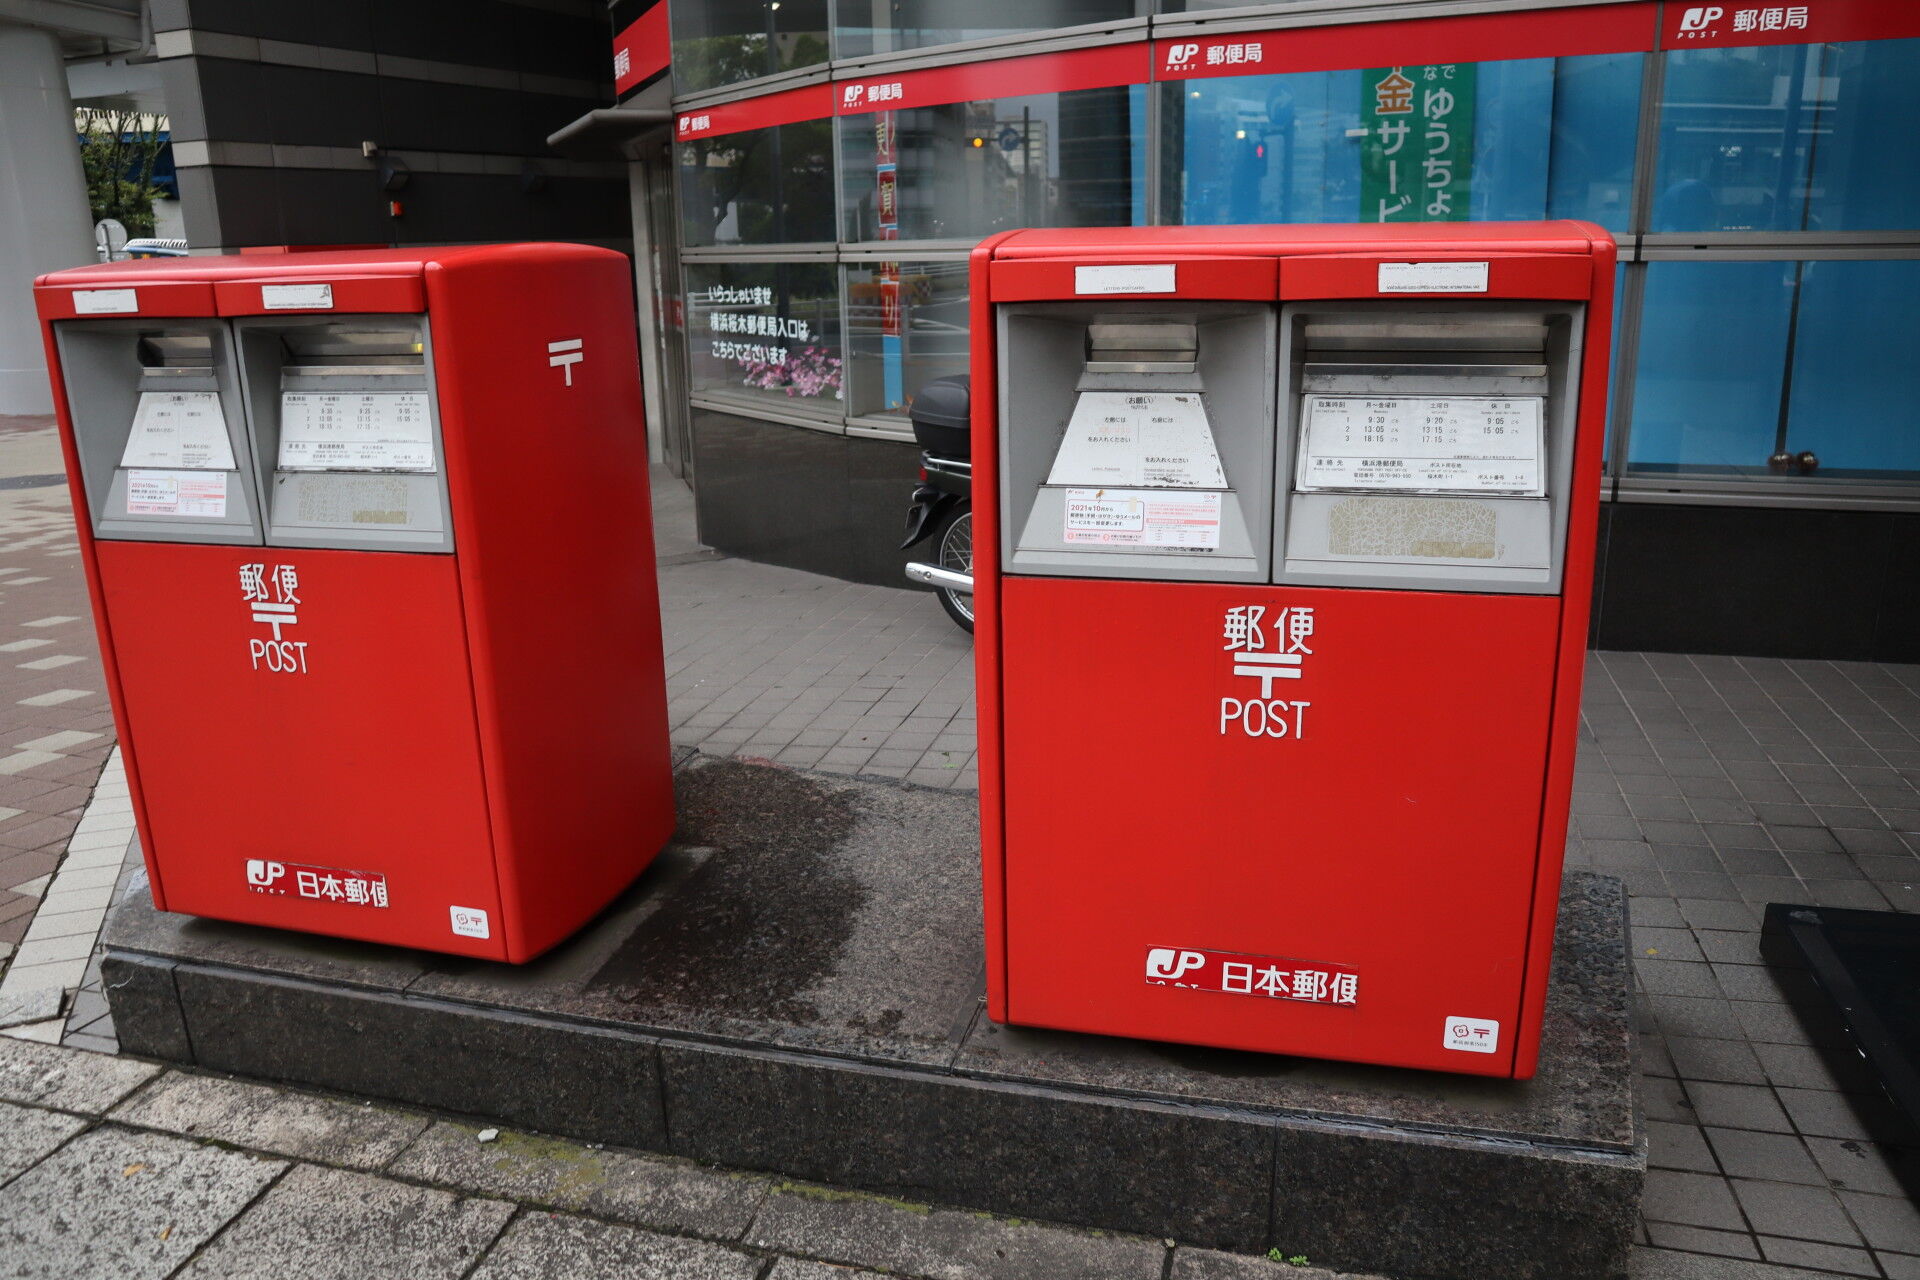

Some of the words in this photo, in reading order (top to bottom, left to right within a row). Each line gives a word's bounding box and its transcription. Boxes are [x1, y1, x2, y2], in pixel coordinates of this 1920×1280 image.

[1733, 6, 1808, 32] 郵便局
[1677, 30, 1717, 39] POST
[1206, 43, 1263, 65] 郵便局
[1166, 64, 1196, 72] POST
[867, 83, 903, 102] 郵便局
[1375, 66, 1416, 223] 金サービ
[708, 285, 772, 305] いらっしゃいませ
[710, 312, 809, 342] 横浜桜木郵便局入口は
[712, 340, 788, 366] こちらでございます
[1364, 425, 1385, 433] 13:05
[1422, 426, 1443, 434] 13:15
[1483, 427, 1504, 435] 15:05
[1368, 416, 1385, 424] 9:30
[1426, 417, 1443, 425] 9:20
[239, 564, 301, 604] 郵便
[1223, 605, 1315, 655] 郵便
[249, 638, 308, 674] POST
[1220, 697, 1312, 740] POST
[296, 871, 389, 908] 日本郵便
[1221, 961, 1358, 1004] 日本郵便
